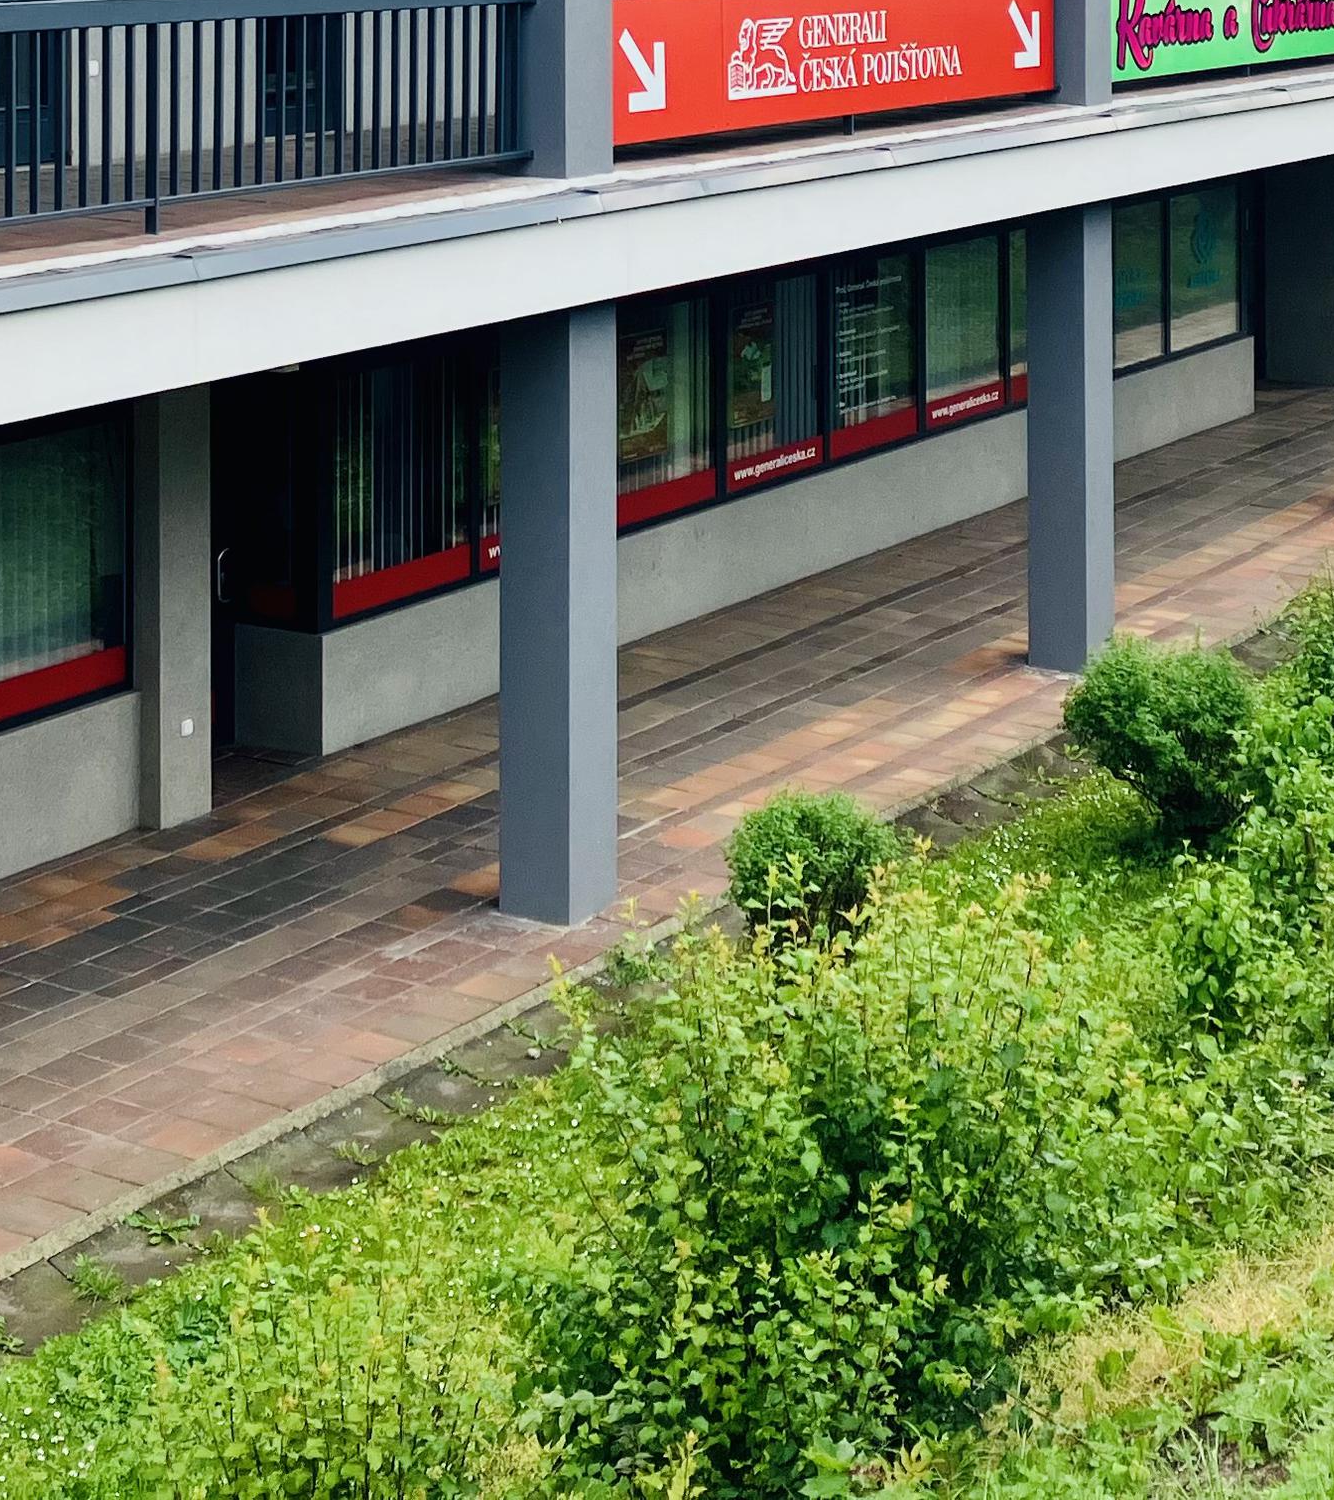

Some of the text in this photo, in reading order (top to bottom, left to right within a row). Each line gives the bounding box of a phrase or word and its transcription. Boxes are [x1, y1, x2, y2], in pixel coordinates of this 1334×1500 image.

[798, 10, 887, 49] GENERALI
[1223, 5, 1239, 40] a
[799, 42, 963, 93] ČESKÁ POJIŠŤOVNA
[734, 447, 816, 481] www.generaliceska.cz
